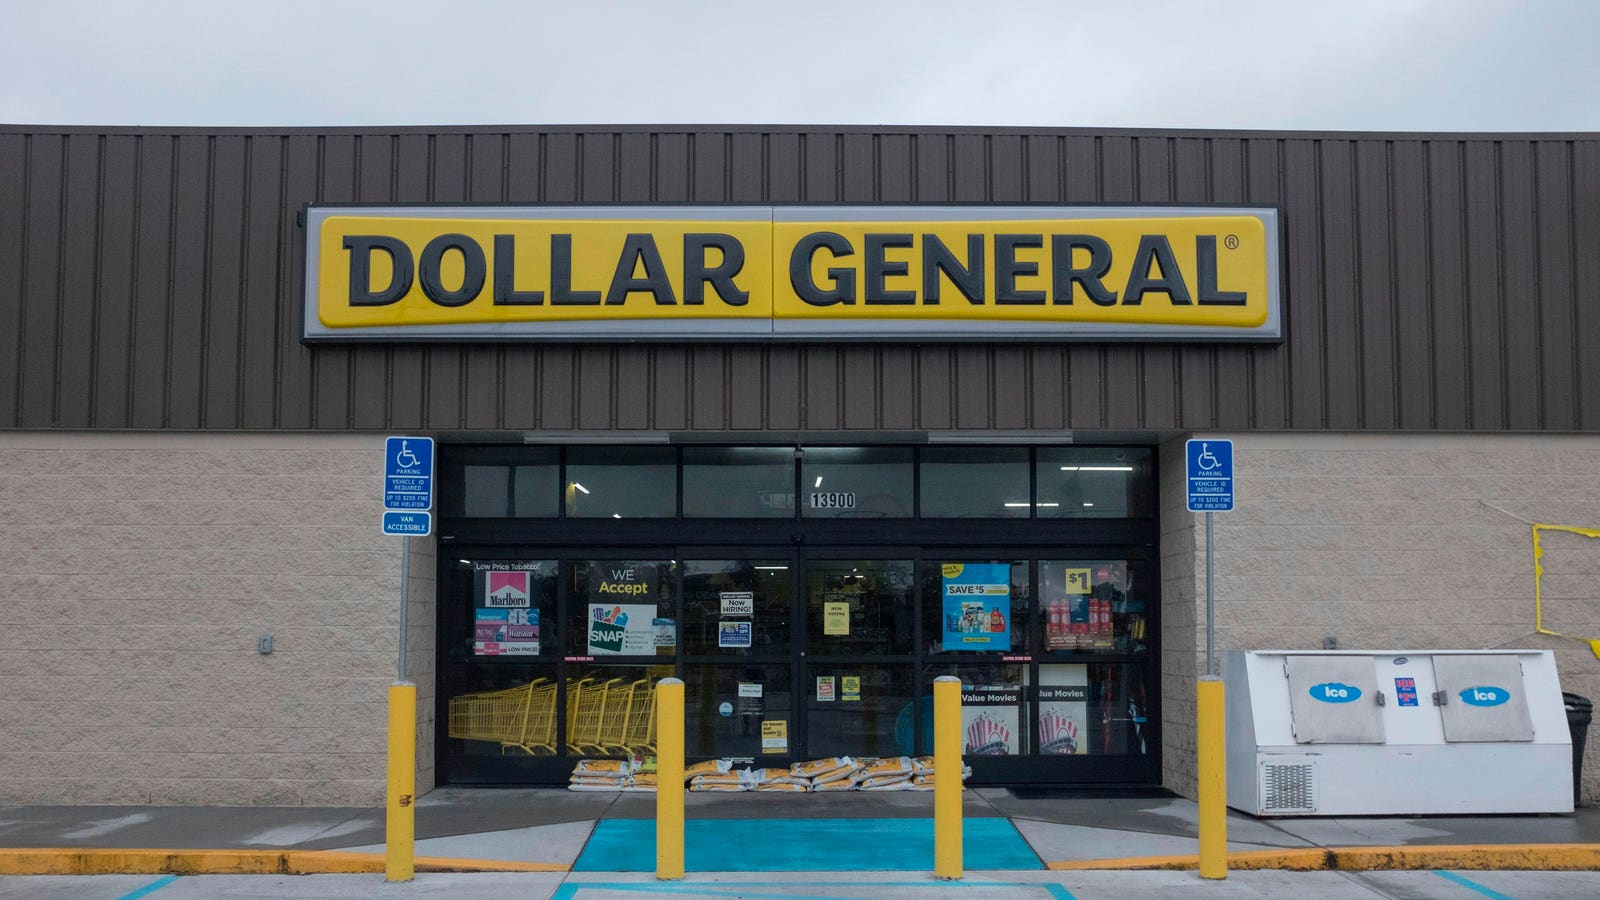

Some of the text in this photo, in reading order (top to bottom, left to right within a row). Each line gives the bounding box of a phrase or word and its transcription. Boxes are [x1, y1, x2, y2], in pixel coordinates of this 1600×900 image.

[342, 233, 750, 307] DOLLAR
[789, 231, 1247, 307] GENERAL
[812, 493, 854, 507] 13900
[387, 523, 426, 531] ACCESSIBLE
[611, 569, 635, 581] WE
[1069, 572, 1088, 590] $1
[599, 581, 648, 596] Accept
[949, 586, 974, 594] SAVE
[490, 592, 526, 606] Marlboro
[590, 630, 624, 642] SNAP
[961, 694, 1017, 702] Value Movies
[1039, 689, 1084, 698] lue Movies
[1325, 686, 1348, 698] Ice
[1474, 689, 1496, 701] Ice
